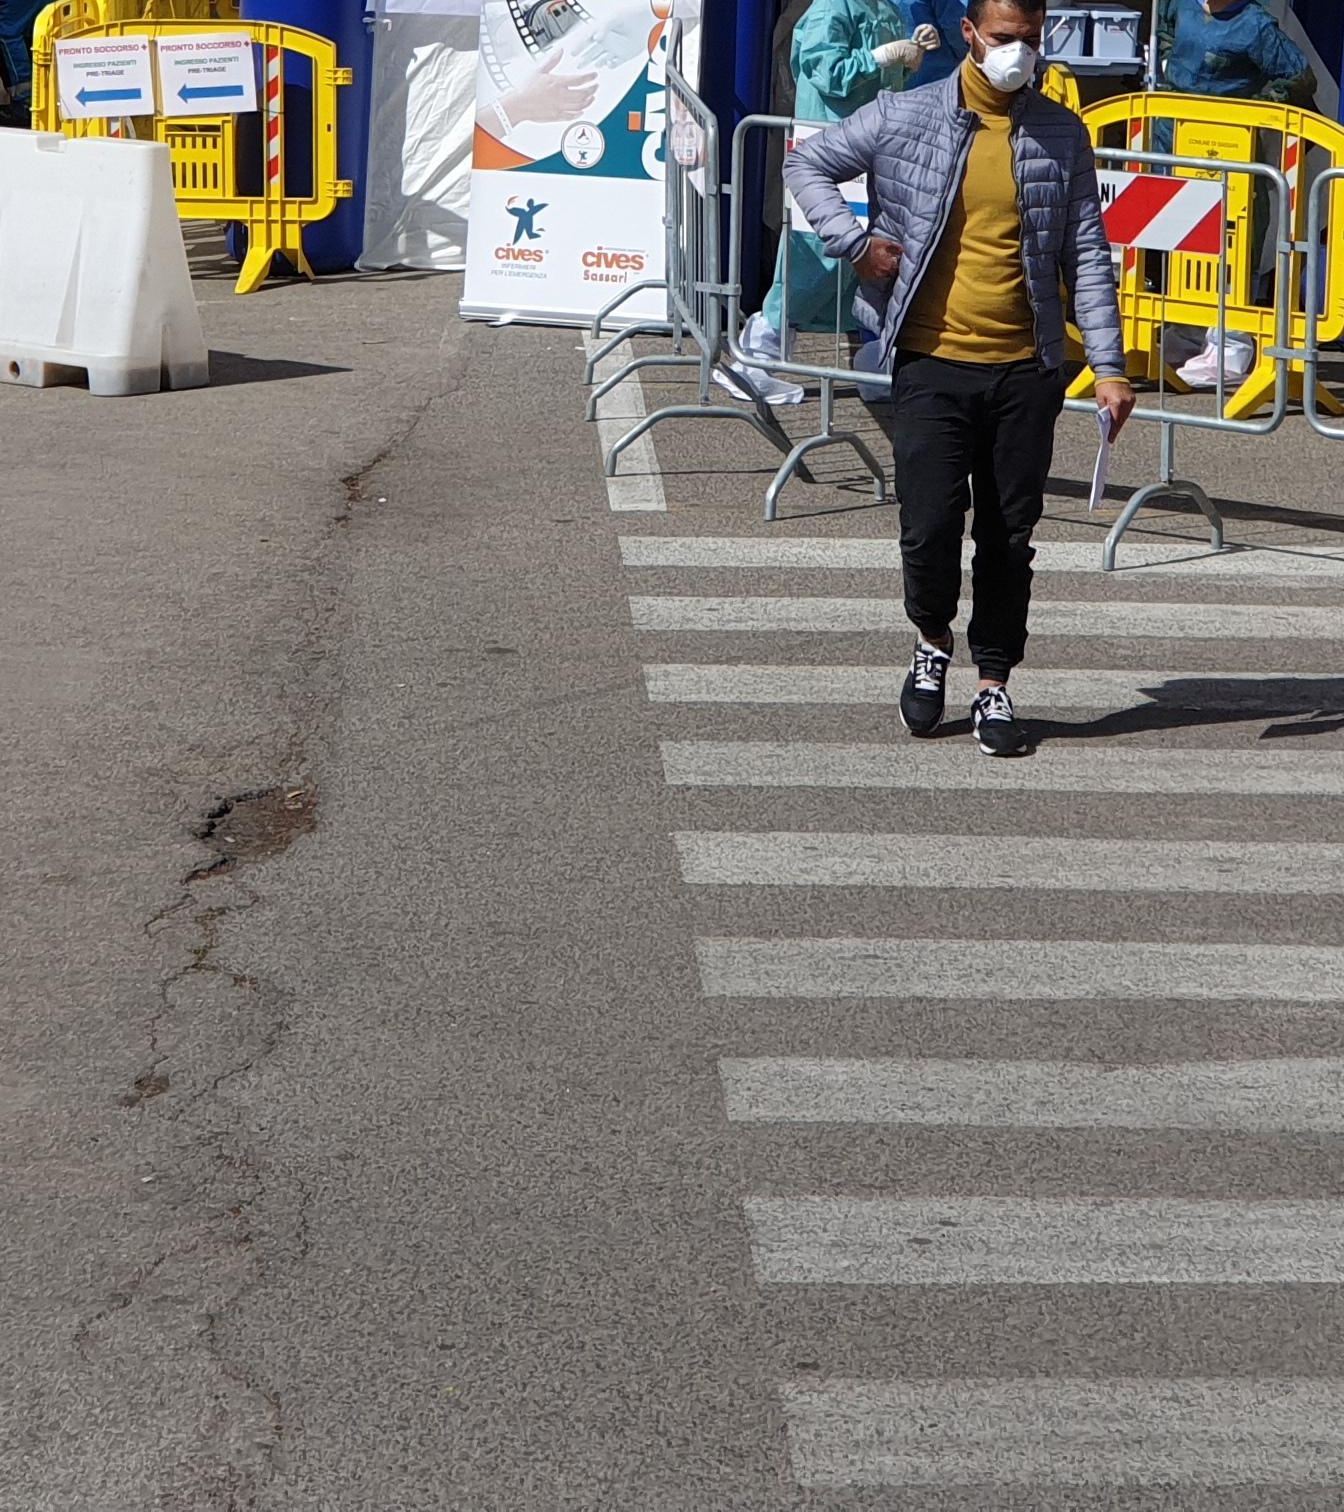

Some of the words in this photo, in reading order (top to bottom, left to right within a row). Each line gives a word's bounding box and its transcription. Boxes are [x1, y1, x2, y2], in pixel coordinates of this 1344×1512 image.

[59, 45, 93, 56] PRONTO
[93, 44, 140, 54] SOCCORSO
[160, 43, 194, 52] PRONTO
[195, 40, 242, 51] SOCCORSO
[494, 242, 544, 263] cives
[581, 245, 645, 272] cives
[582, 269, 628, 283] Sassari
